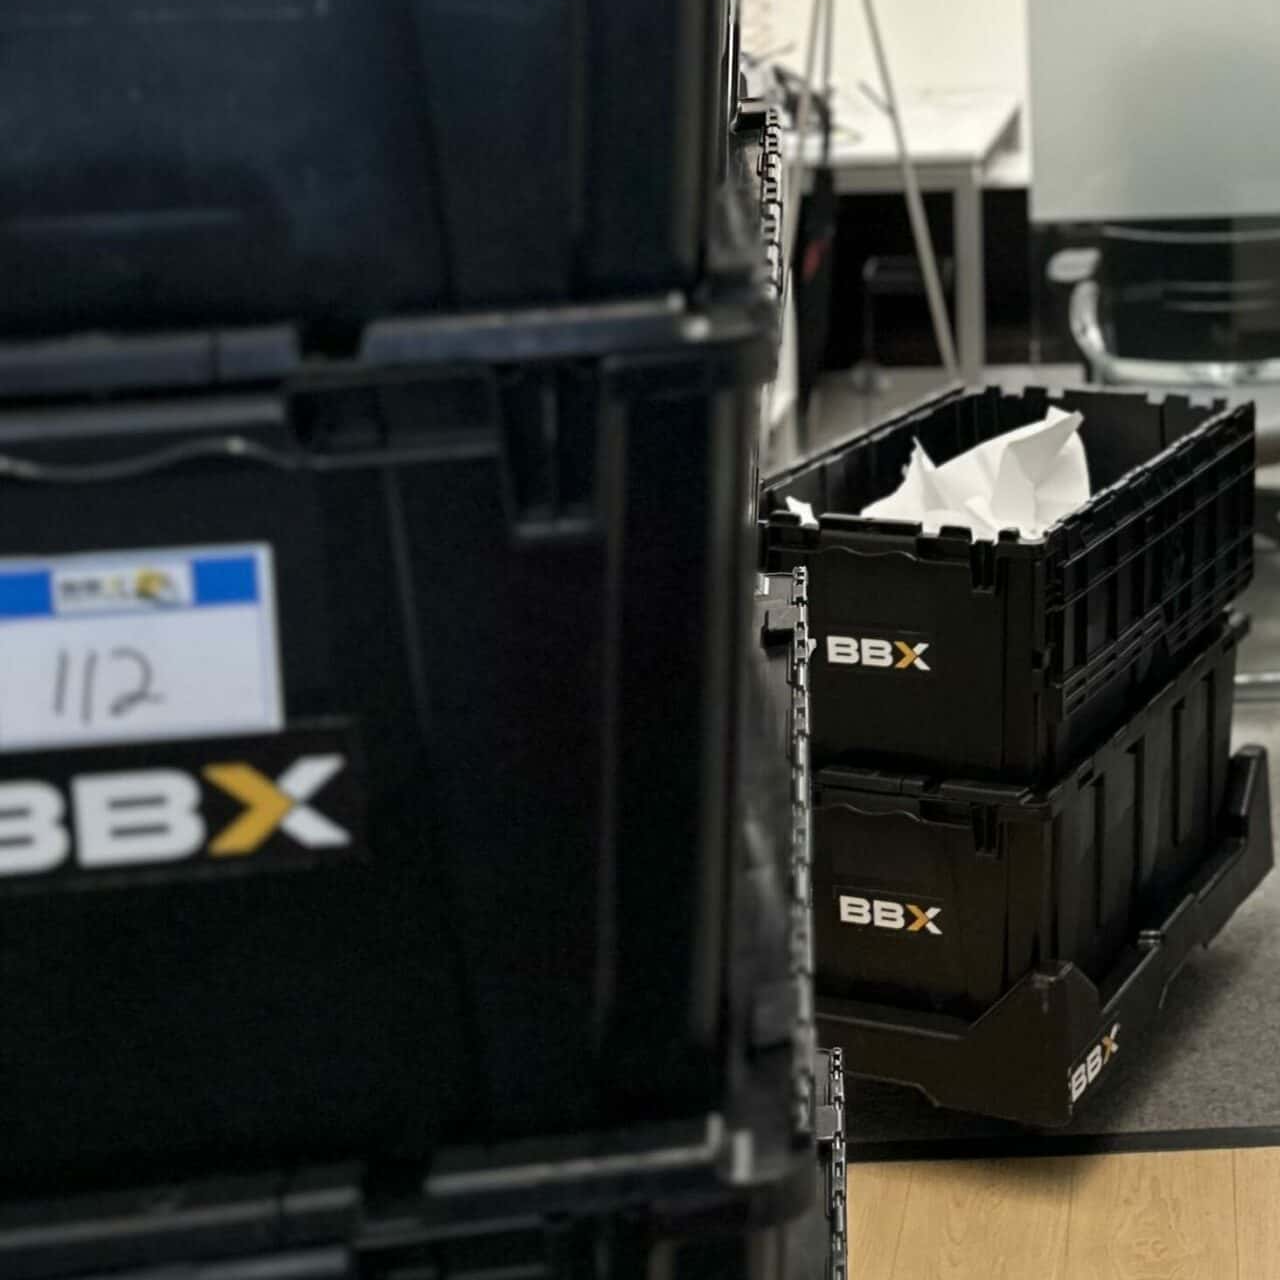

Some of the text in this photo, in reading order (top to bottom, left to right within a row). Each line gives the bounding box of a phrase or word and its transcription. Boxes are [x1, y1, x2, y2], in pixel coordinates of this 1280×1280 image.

[826, 635, 931, 671] BBX
[52, 644, 164, 726] 112
[839, 895, 943, 935] BBX
[1071, 1023, 1121, 1102] BBX
